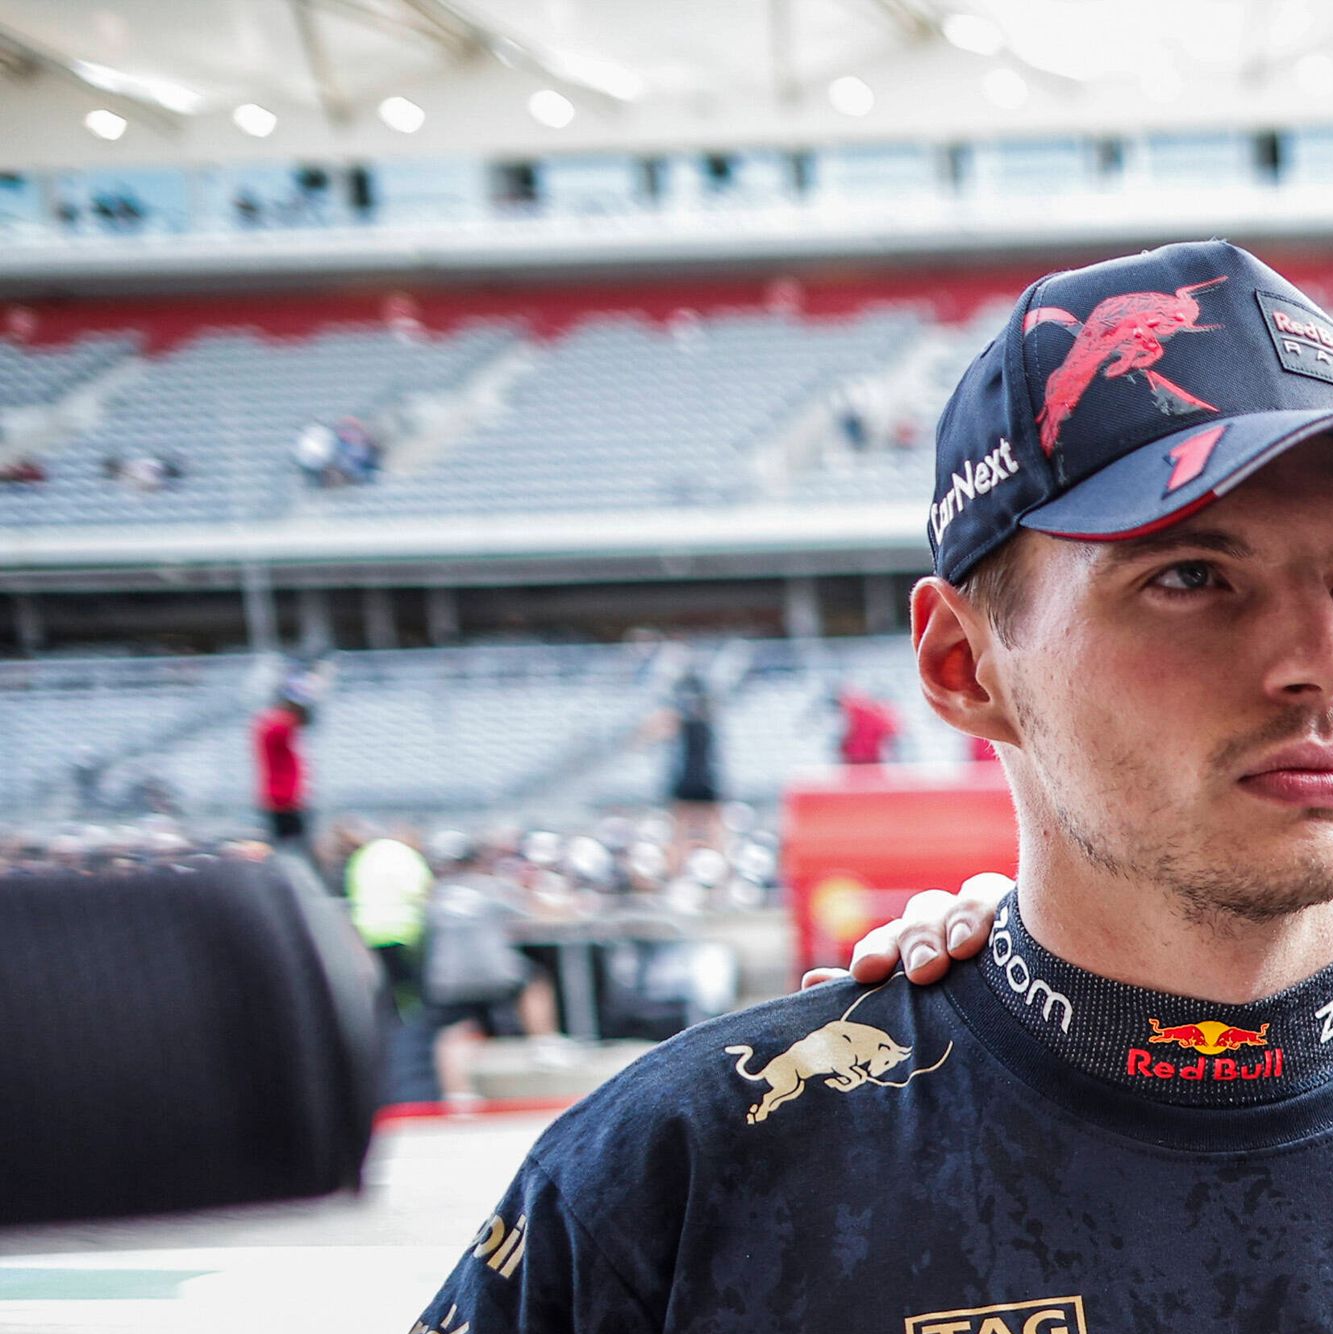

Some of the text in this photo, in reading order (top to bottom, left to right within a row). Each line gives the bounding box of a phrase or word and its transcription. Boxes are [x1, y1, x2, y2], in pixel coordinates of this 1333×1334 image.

[931, 437, 1020, 546] CarNext
[1164, 424, 1228, 499] 1
[1127, 1047, 1284, 1081] Red Bull
